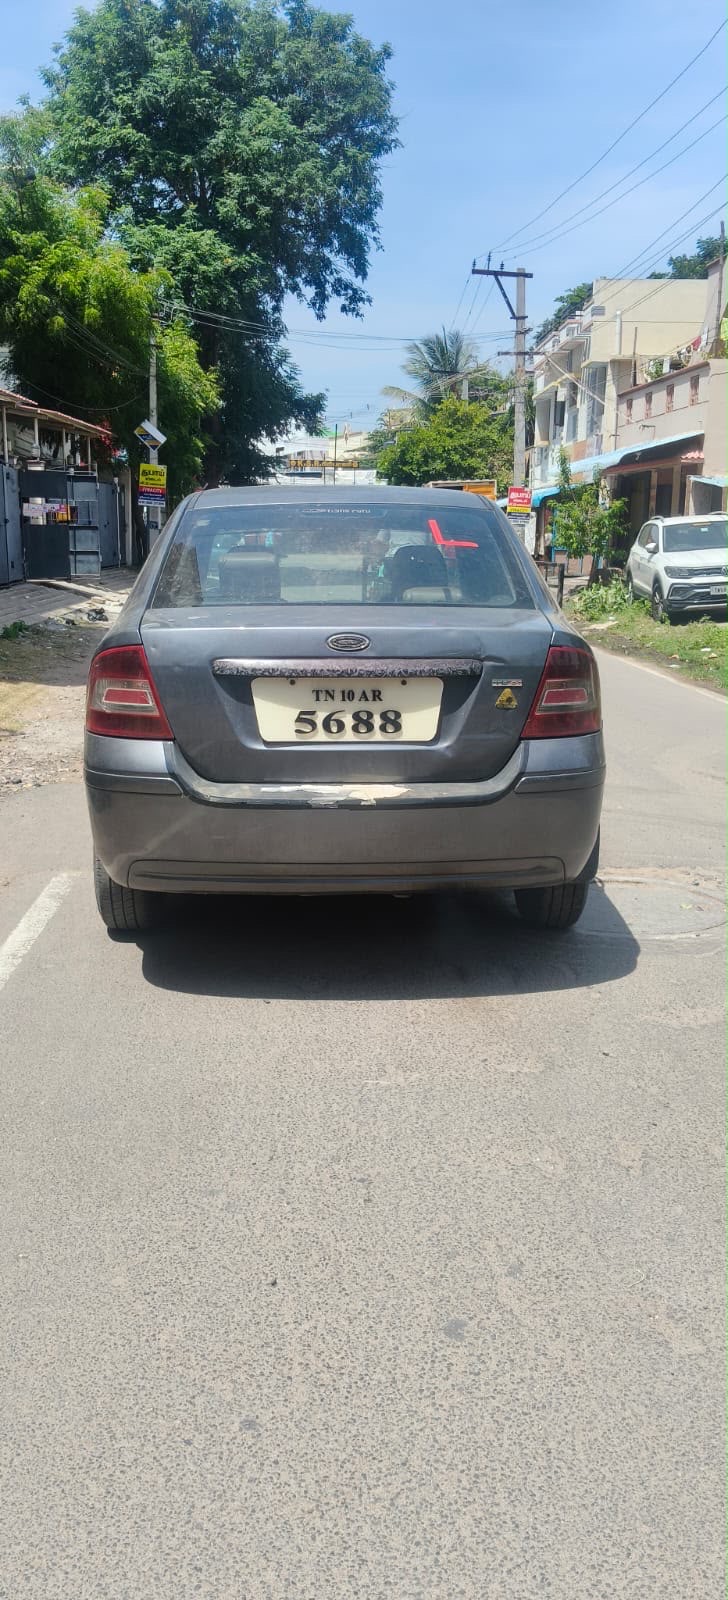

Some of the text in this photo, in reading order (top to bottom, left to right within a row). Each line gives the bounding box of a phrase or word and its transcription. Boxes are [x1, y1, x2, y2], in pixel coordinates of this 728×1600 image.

[312, 689, 384, 702] TN 10 AR
[294, 709, 402, 735] 5688
